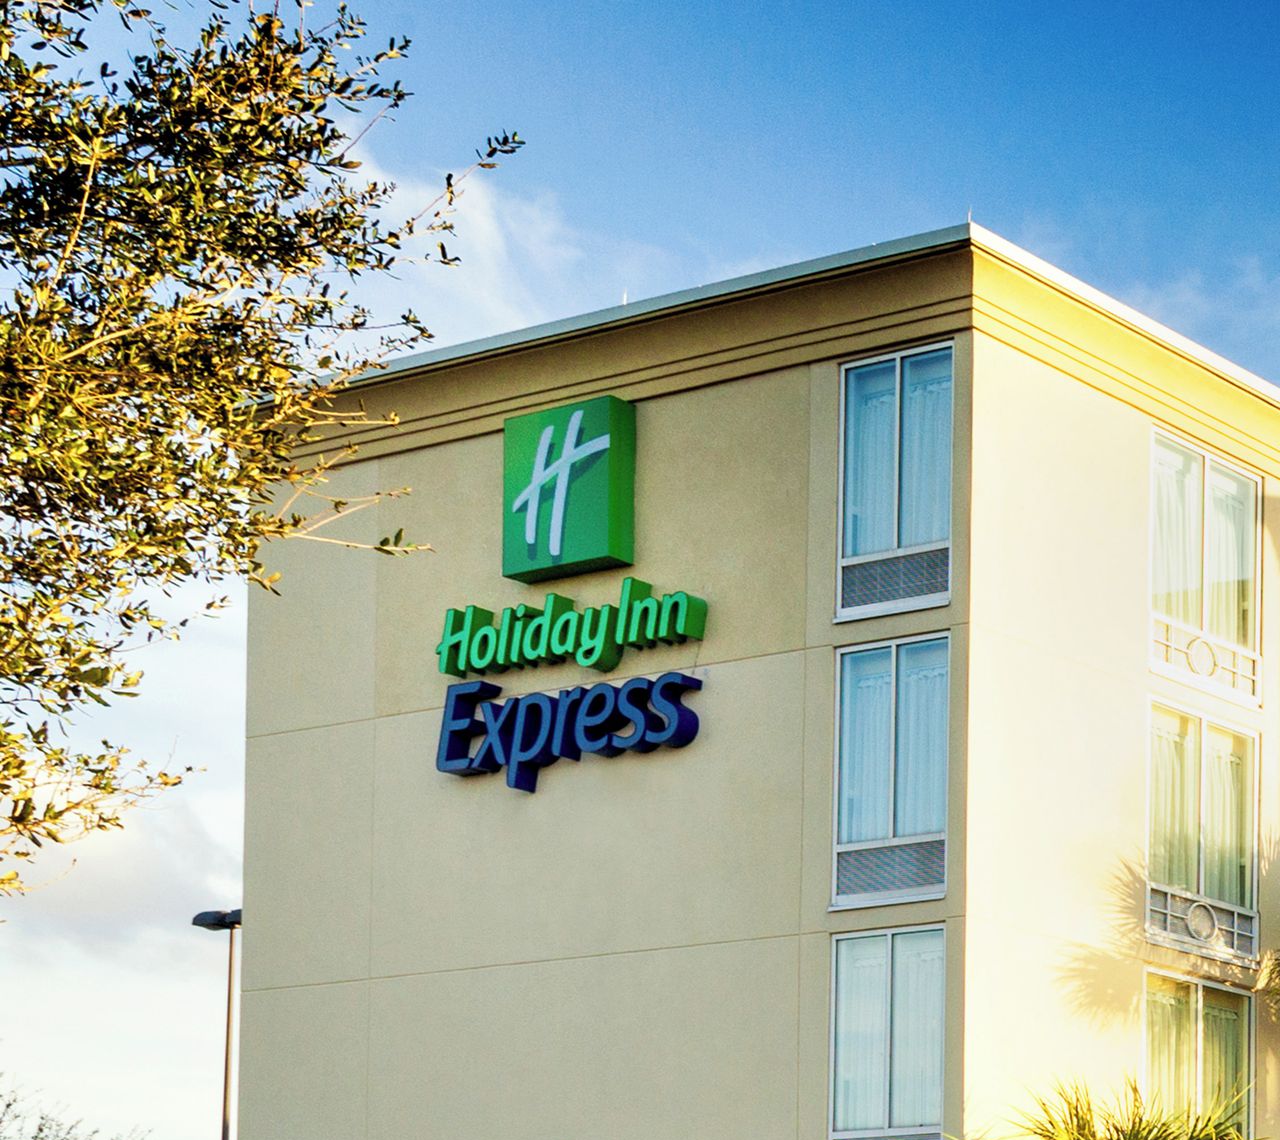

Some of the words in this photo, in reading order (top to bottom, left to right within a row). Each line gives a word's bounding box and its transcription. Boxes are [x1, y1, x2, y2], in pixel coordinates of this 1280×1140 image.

[436, 593, 622, 679] Holiday
[615, 576, 705, 650] Inn
[436, 672, 703, 792] Express
